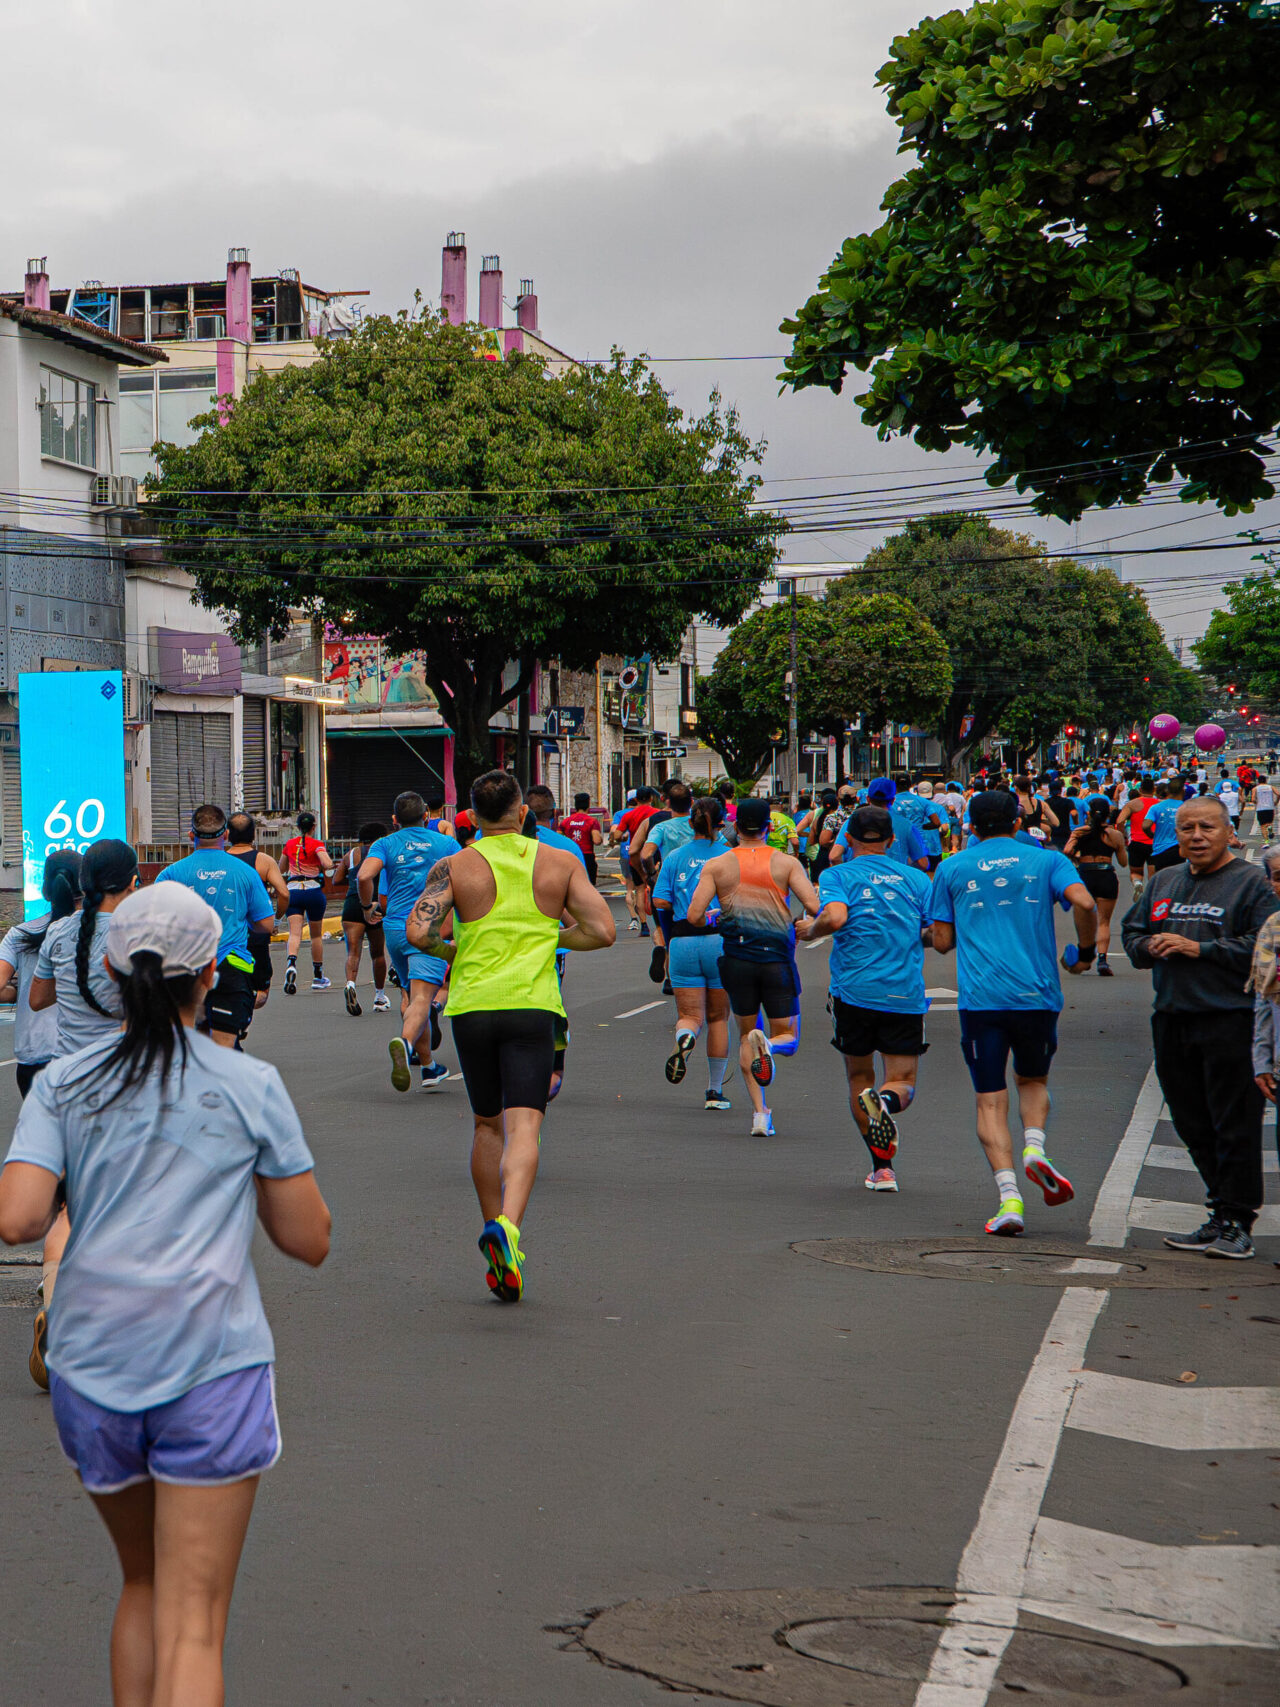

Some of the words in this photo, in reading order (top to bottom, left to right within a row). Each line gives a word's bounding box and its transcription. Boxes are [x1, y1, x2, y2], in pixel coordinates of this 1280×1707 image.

[43, 798, 105, 840] 60
[421, 903, 435, 915] 23
[1170, 902, 1224, 917] lotto
